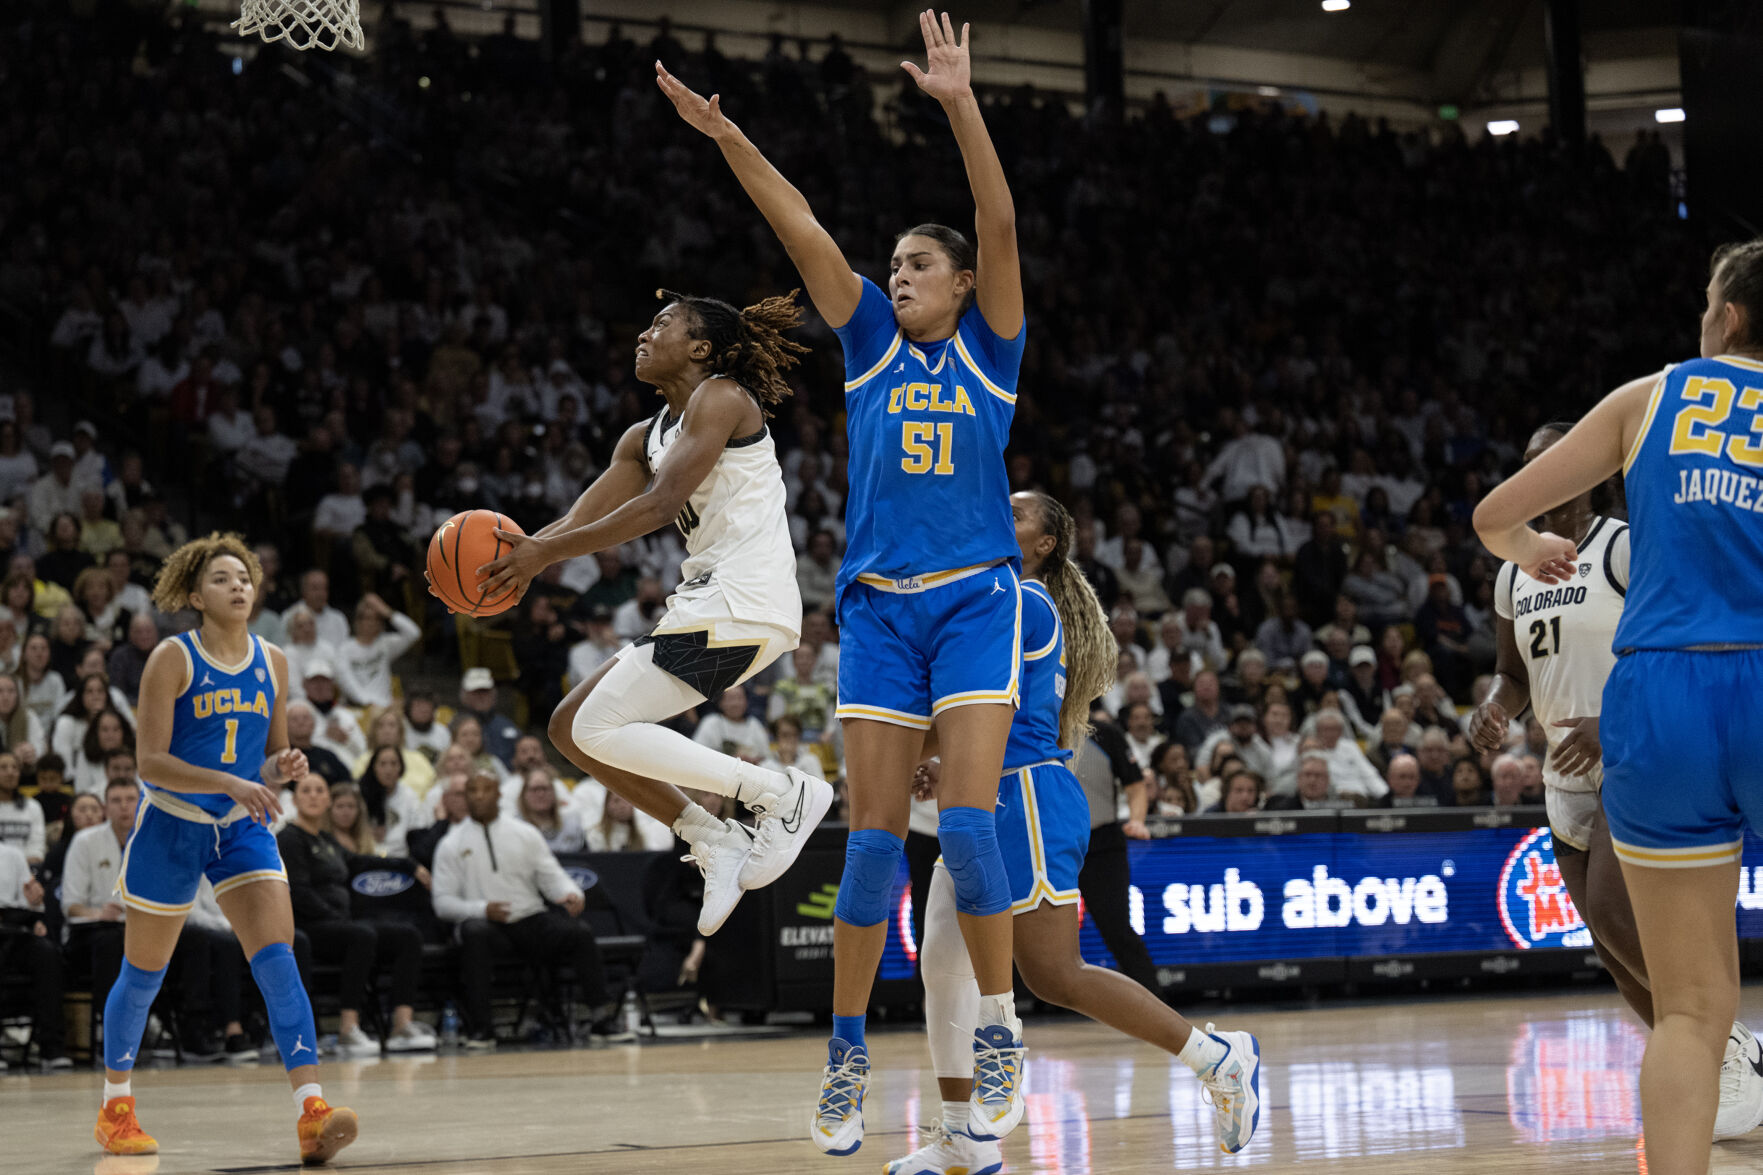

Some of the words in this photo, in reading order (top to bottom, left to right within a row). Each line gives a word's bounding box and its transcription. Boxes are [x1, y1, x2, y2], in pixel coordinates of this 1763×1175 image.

[887, 382, 976, 417] UCLA
[1669, 375, 1763, 468] 23
[901, 421, 954, 475] 51
[1515, 586, 1588, 620] COLORADO
[1529, 615, 1562, 660] 21
[192, 688, 270, 719] UCLA
[220, 718, 239, 764] 1
[1162, 867, 1265, 934] sub
[1282, 864, 1449, 929] above
